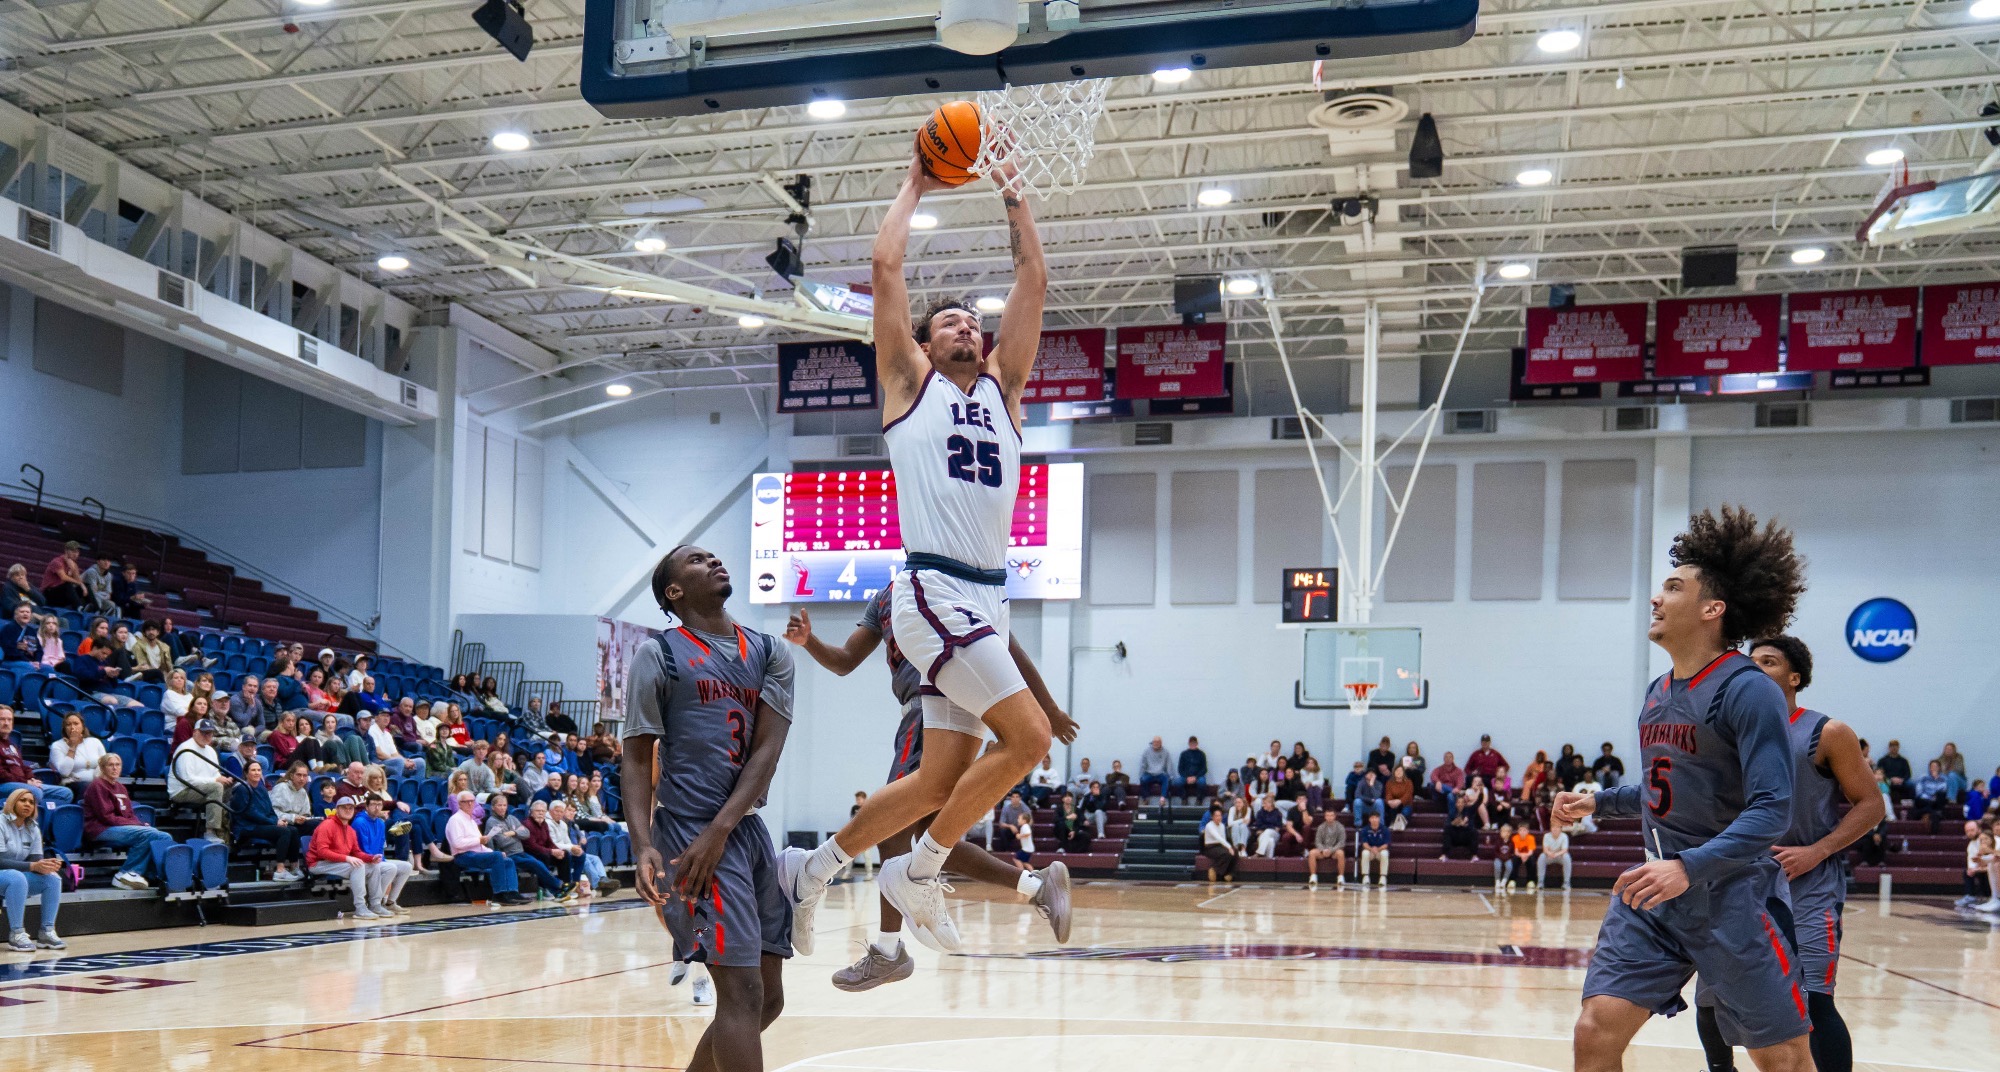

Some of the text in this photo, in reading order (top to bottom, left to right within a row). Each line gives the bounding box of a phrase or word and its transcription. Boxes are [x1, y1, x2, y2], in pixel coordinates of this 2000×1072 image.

[809, 346, 846, 359] NAIA
[1132, 352, 1210, 365] CHAMPIONS
[796, 356, 859, 370] NATIONAL
[1144, 363, 1197, 376] SOFTBALL
[792, 366, 863, 380] CHAMPIONS
[950, 402, 996, 435] LEE
[947, 434, 1002, 488] 25
[755, 550, 779, 559] LEE
[837, 557, 857, 586] 4
[1851, 629, 1915, 647] NCAA
[727, 709, 746, 766] 3
[1648, 757, 1673, 818] 5
